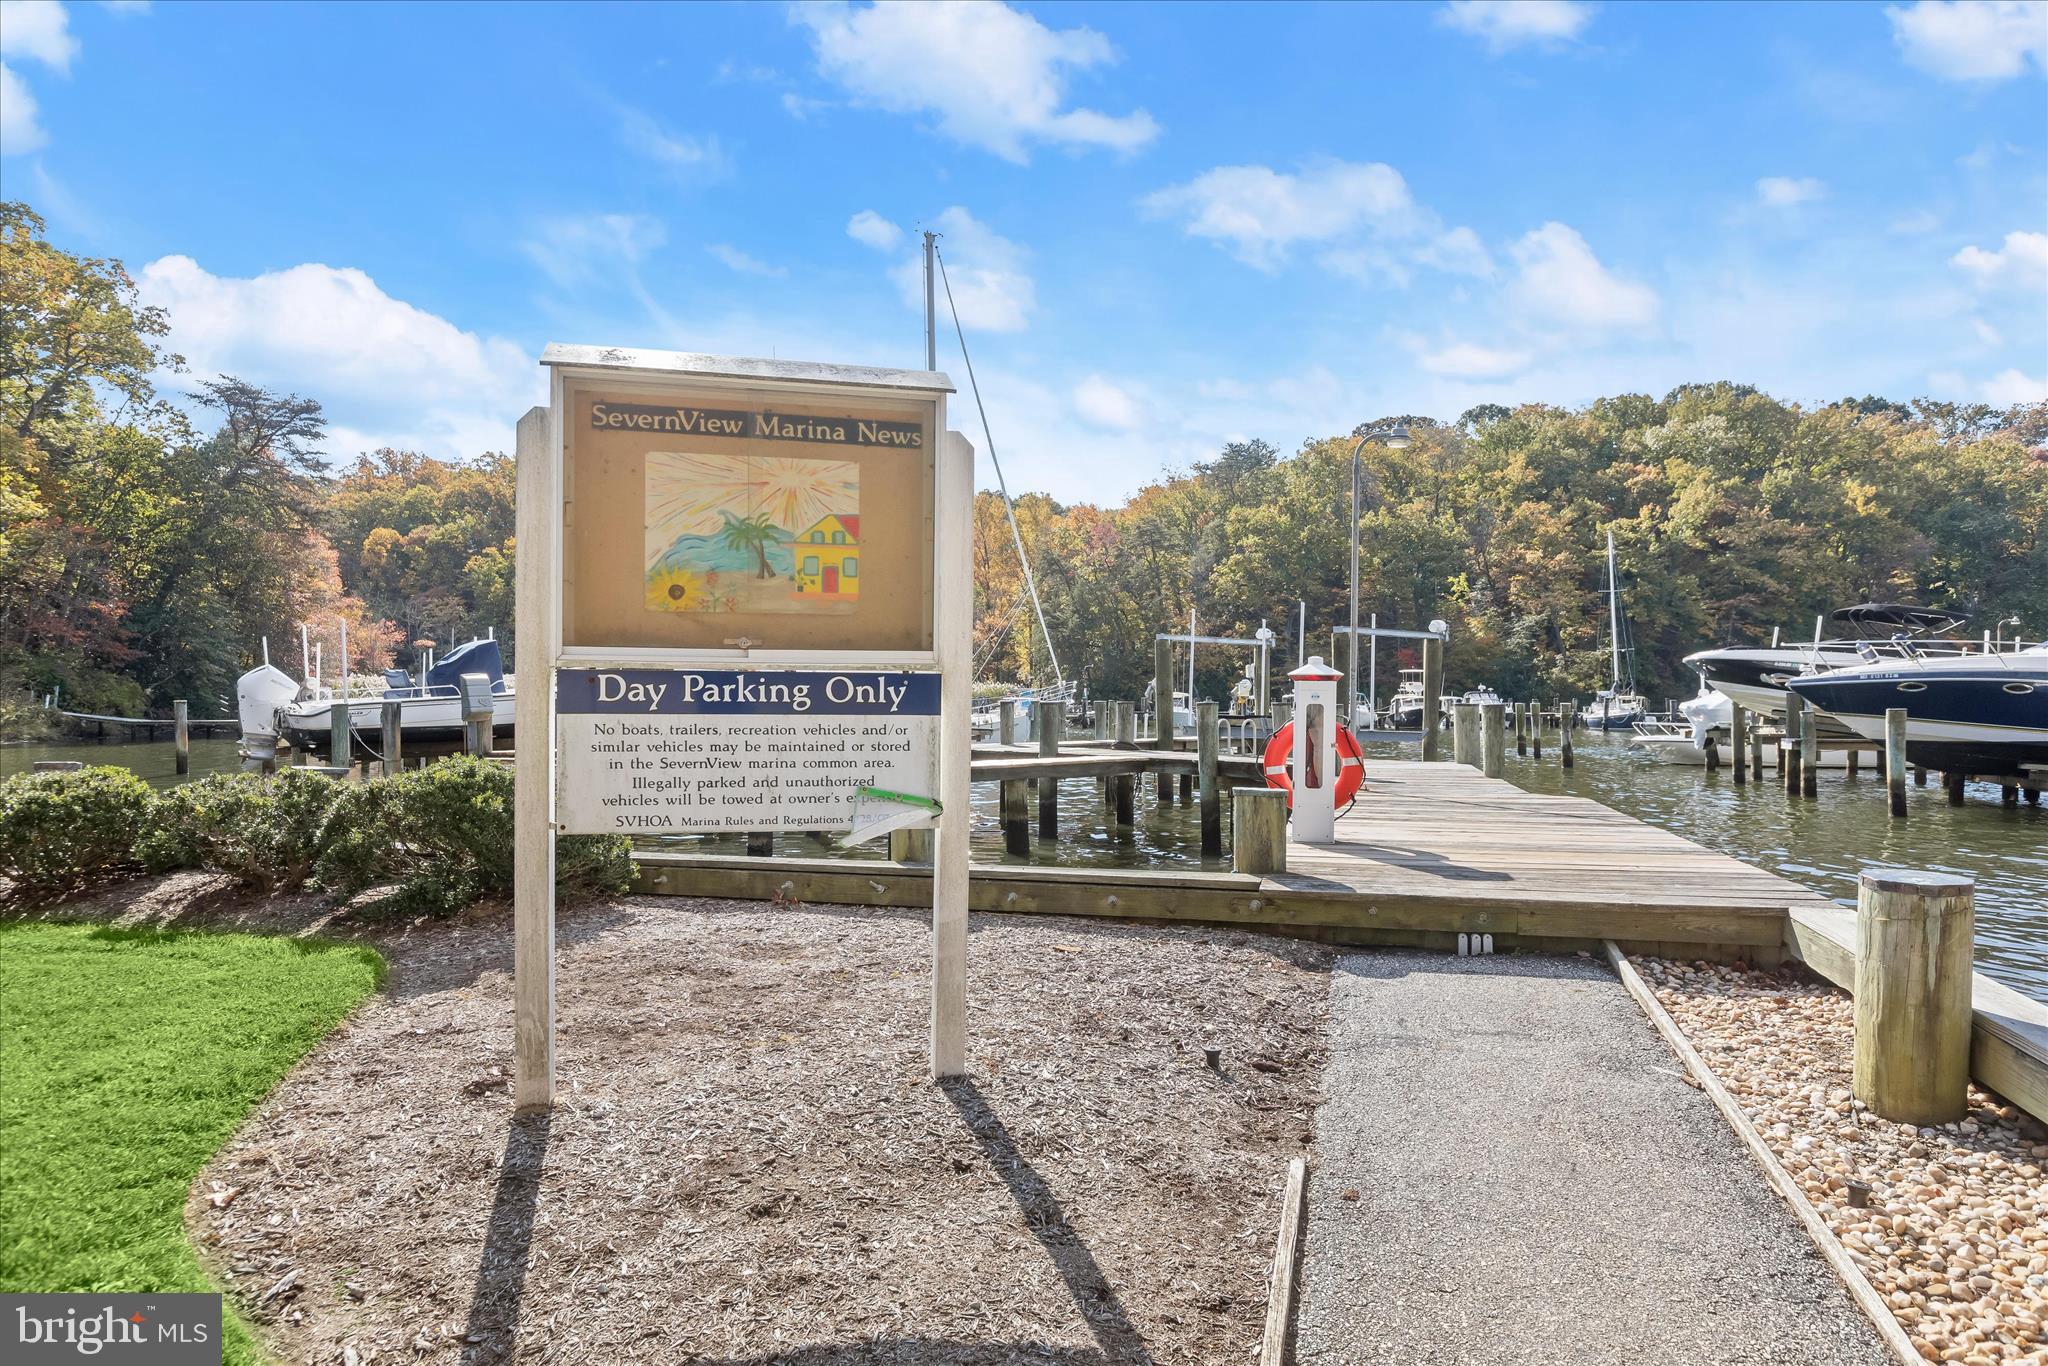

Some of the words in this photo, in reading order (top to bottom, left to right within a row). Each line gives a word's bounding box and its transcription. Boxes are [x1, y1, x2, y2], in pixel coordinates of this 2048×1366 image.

[592, 405, 743, 434] SevernView
[755, 415, 845, 442] Marina
[857, 422, 922, 446] News
[597, 674, 667, 711] Day
[682, 674, 811, 711] Parking
[825, 676, 908, 712] Only
[594, 723, 615, 735] No
[622, 723, 663, 737] boats,
[670, 724, 722, 737] trailers,
[728, 724, 796, 736] recreation
[803, 724, 856, 735] vehicles
[862, 723, 909, 736] and/or
[591, 741, 640, 752] similar
[647, 740, 703, 752] vehicles
[710, 743, 738, 755] may
[745, 741, 761, 752] be
[768, 740, 845, 752] maintained
[851, 743, 865, 752] or
[871, 740, 910, 752] stored
[609, 758, 623, 770] in
[630, 758, 653, 769] the
[660, 757, 742, 770] SevernView
[748, 758, 796, 769] marina
[803, 759, 858, 769] common
[864, 760, 895, 769] area.
[632, 777, 690, 791] Illegally
[697, 776, 746, 791] parked
[752, 776, 779, 787] and
[785, 775, 875, 787] unauthorized
[602, 794, 659, 806] vehicles
[666, 794, 692, 805] will
[699, 794, 716, 805] be
[722, 793, 763, 805] towed
[769, 794, 782, 804] at
[788, 792, 840, 804] owner's
[615, 815, 672, 827] SVHOA
[681, 817, 720, 826] Marina
[725, 816, 754, 826] Rules
[758, 815, 778, 825] and
[783, 815, 844, 827] Regulations
